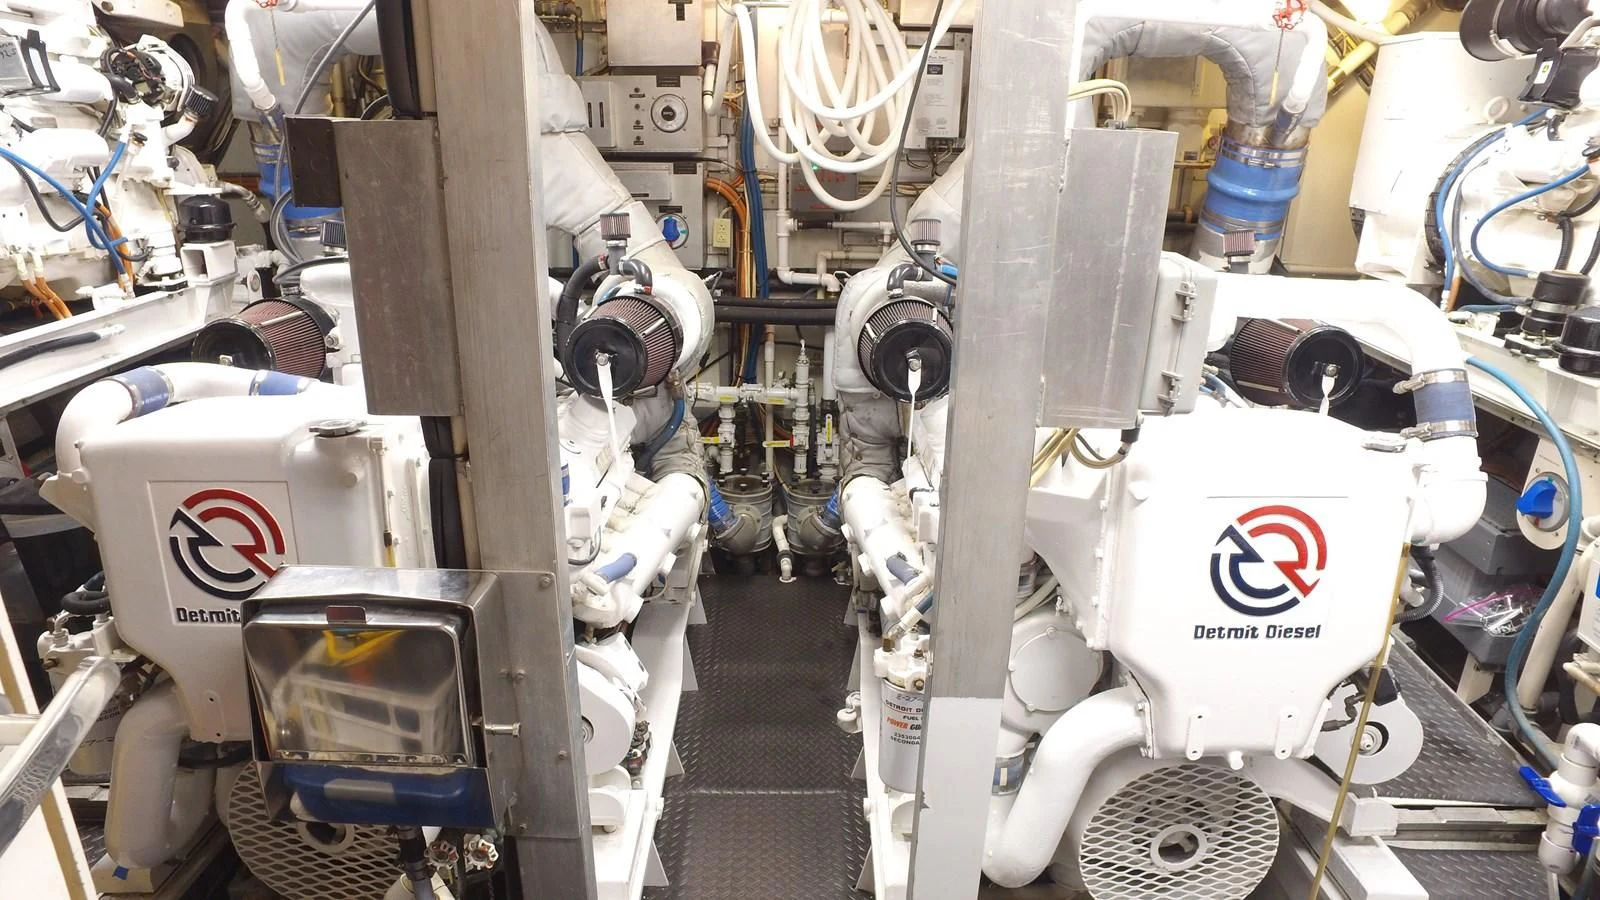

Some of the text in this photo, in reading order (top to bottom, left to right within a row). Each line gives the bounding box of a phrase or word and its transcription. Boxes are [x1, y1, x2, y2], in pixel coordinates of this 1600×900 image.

[176, 608, 241, 623] Detroit
[1194, 624, 1321, 639] Detroit Diesel
[885, 700, 913, 712] DETROIT
[887, 717, 909, 729] POWER
